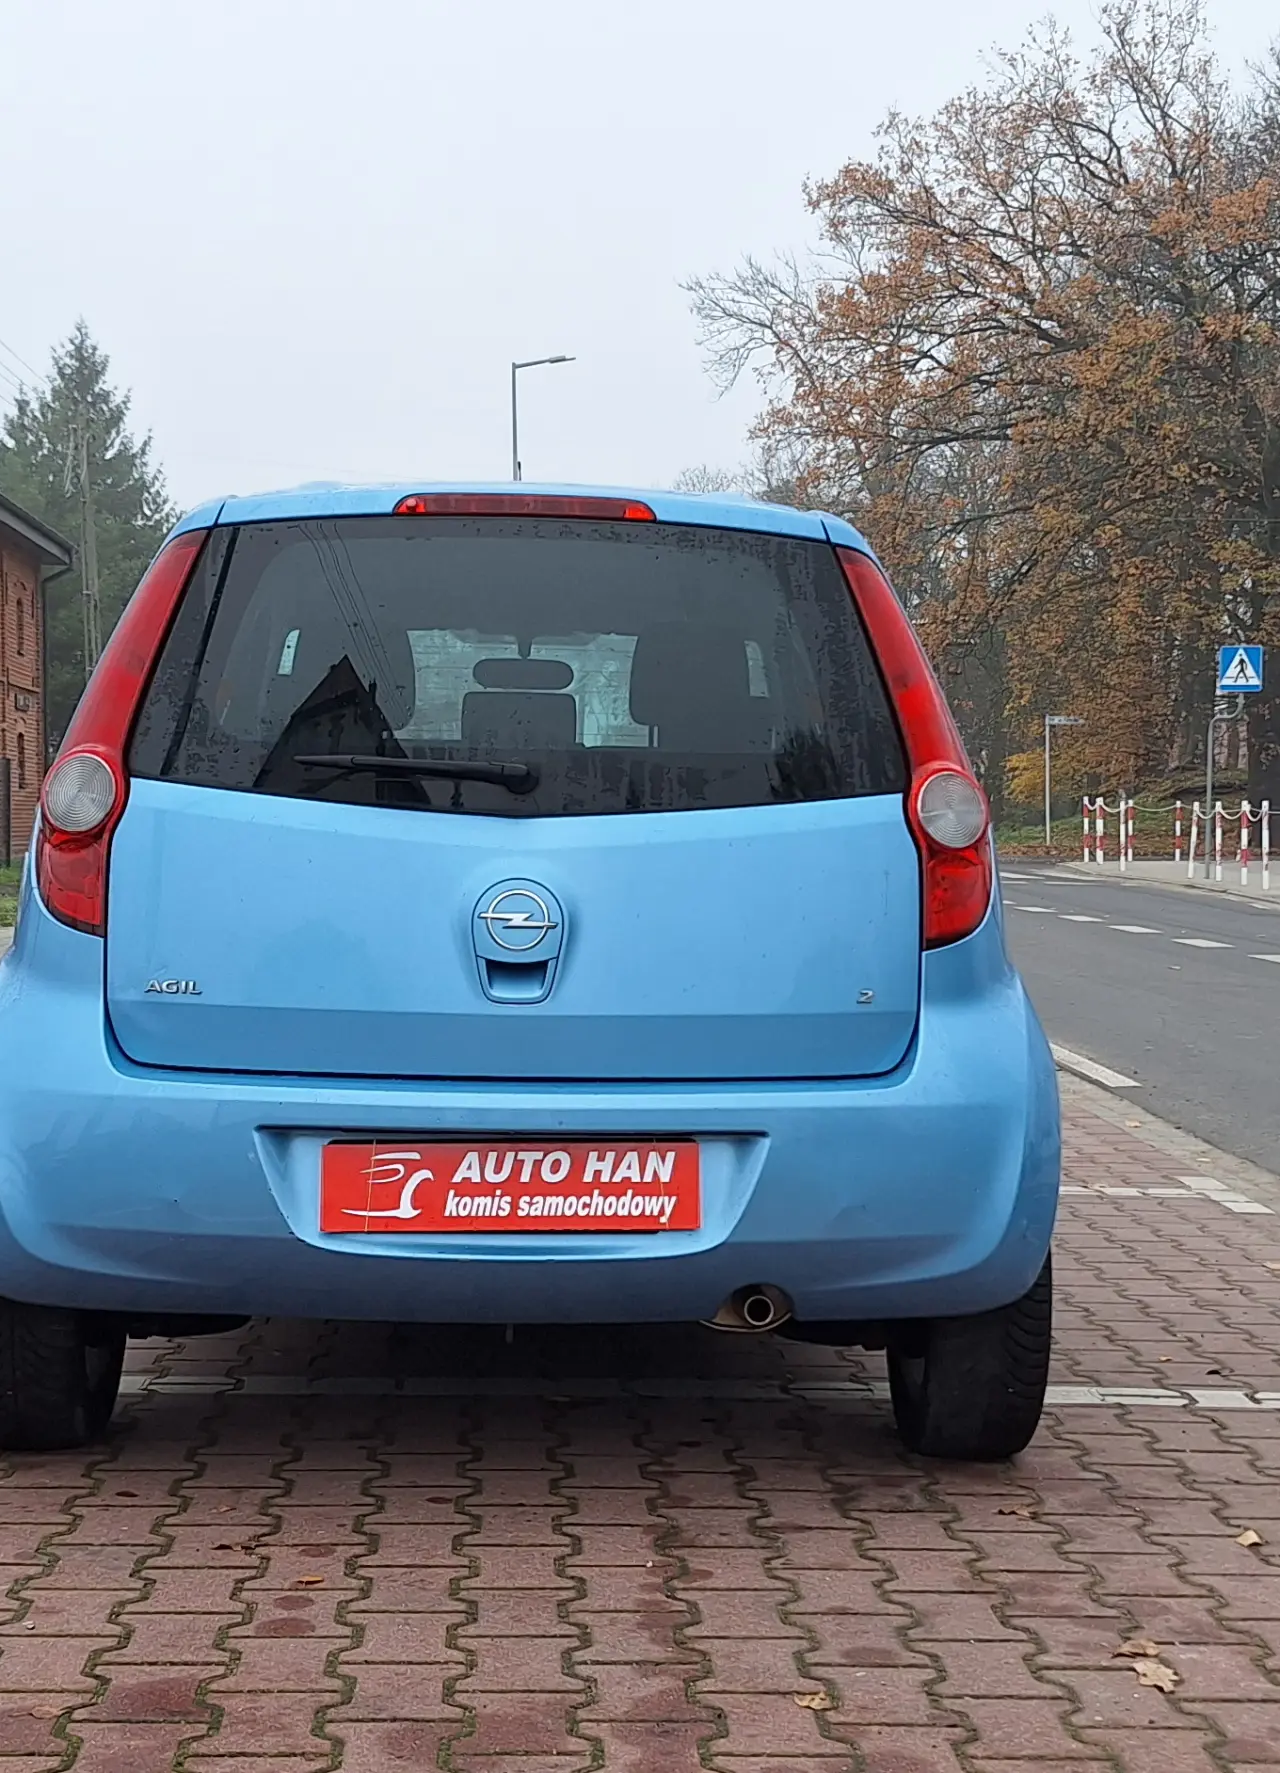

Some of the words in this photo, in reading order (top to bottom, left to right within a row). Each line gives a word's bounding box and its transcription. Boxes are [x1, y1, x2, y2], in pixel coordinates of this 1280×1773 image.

[144, 979, 204, 995] AGIL
[856, 988, 874, 1004] 2
[451, 1150, 571, 1183] AUTO
[582, 1151, 676, 1184] HAN
[443, 1188, 512, 1218] komis
[517, 1188, 677, 1224] samochodowy
